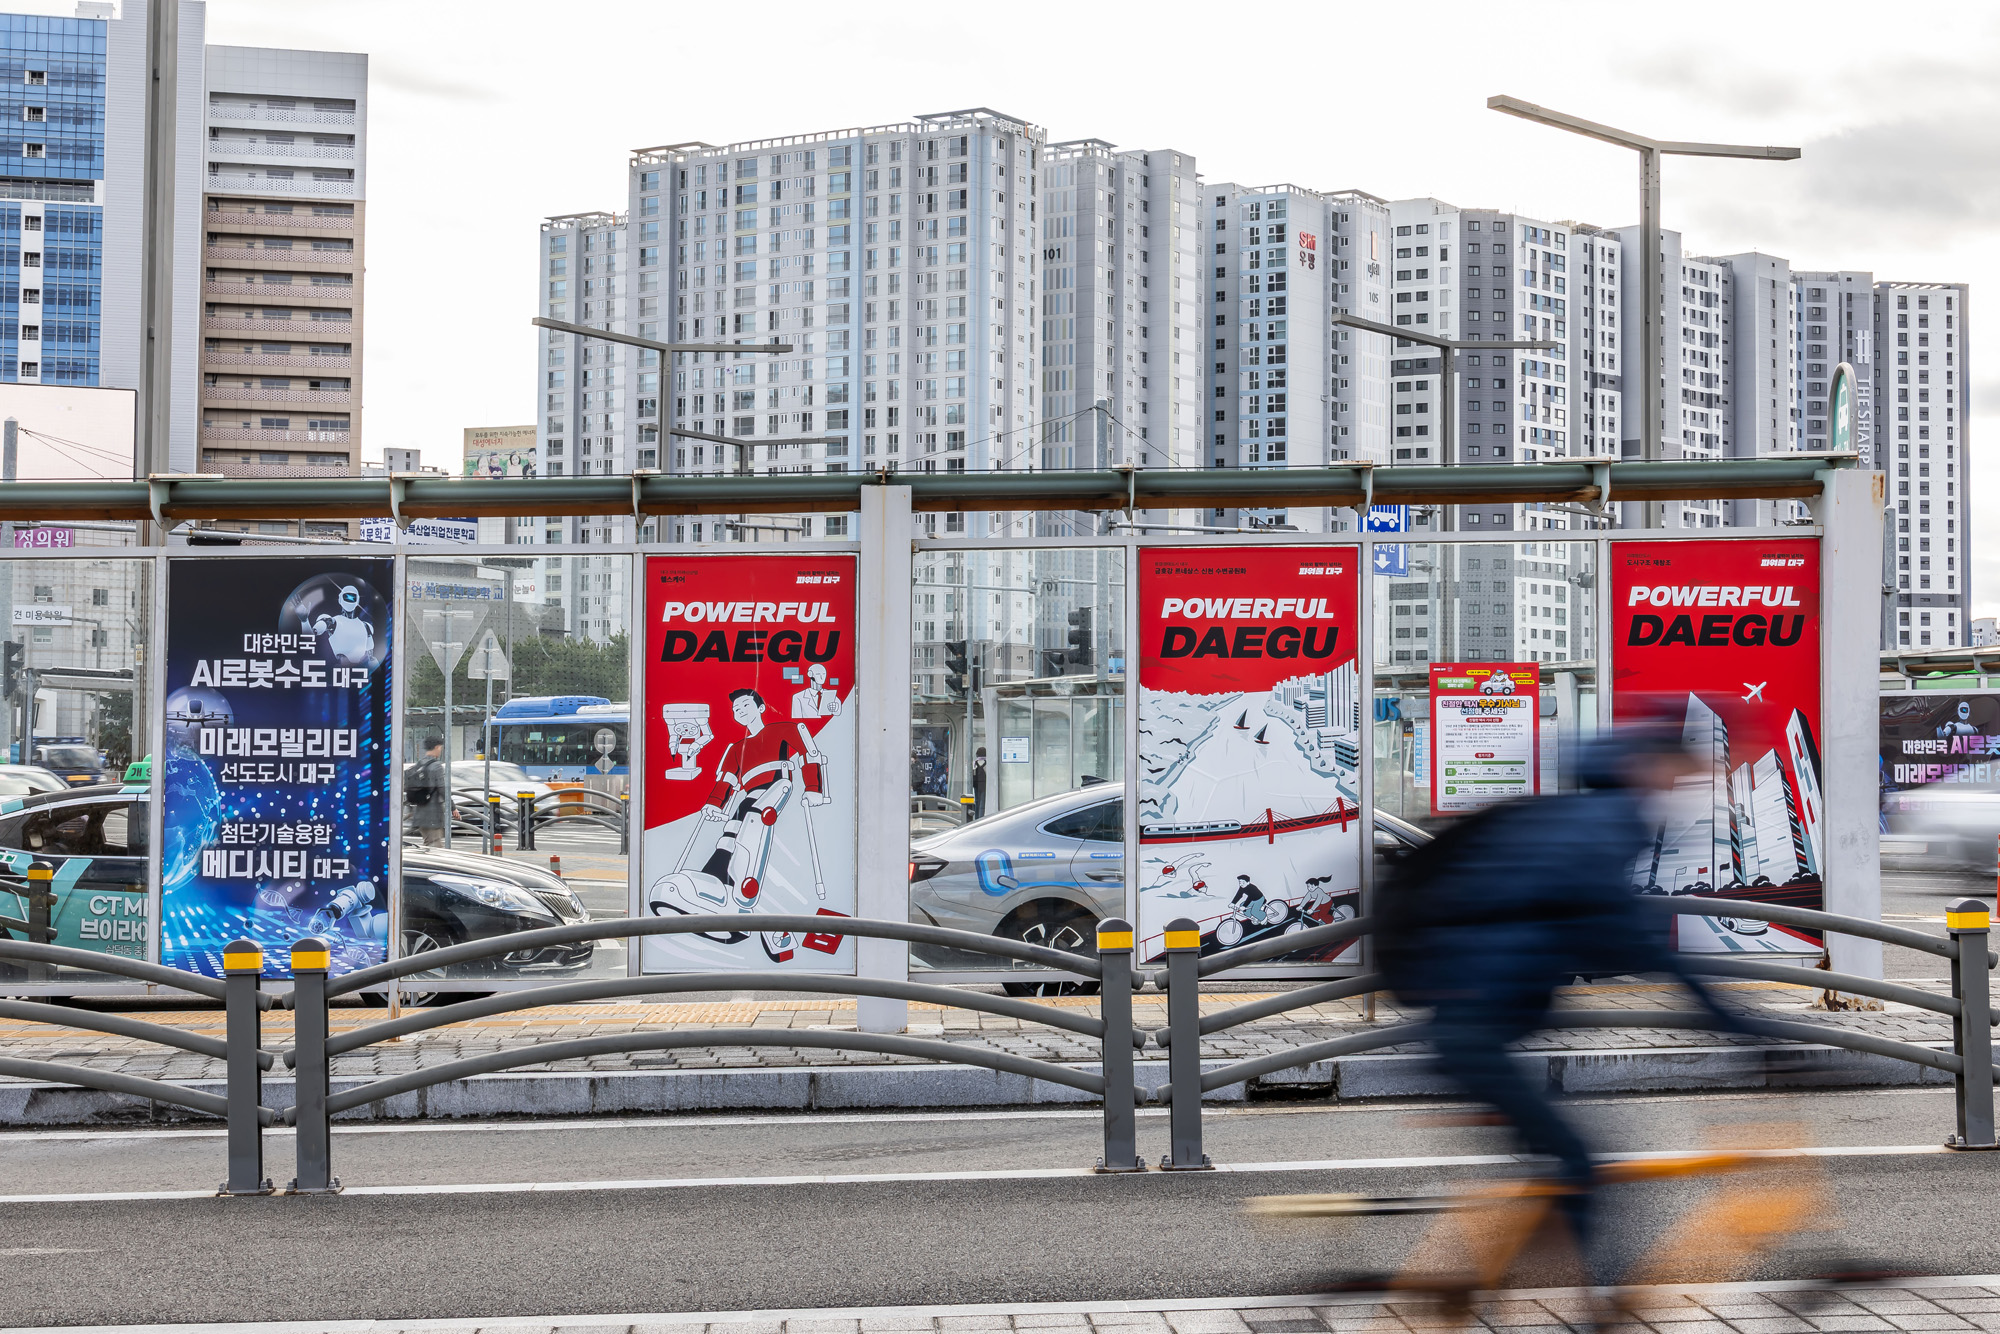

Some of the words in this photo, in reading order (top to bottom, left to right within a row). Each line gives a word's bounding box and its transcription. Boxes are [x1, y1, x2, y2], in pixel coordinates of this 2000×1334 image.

[1299, 231, 1316, 251] SM
[1043, 248, 1061, 260] 101
[1299, 251, 1315, 270] 우방
[1369, 292, 1379, 303] 105
[472, 438, 503, 448] 대성에너지
[14, 529, 70, 548] 성의원
[1155, 567, 1173, 575] 금호강
[1175, 567, 1200, 575] 르네상스
[1325, 567, 1343, 575] 대구
[1787, 559, 1805, 567] 대구
[823, 576, 840, 584] 대구
[407, 585, 503, 600] 업직업전문학교
[1628, 586, 1800, 607] POWERFUL
[662, 601, 836, 623] POWERFUL
[1161, 598, 1334, 619] POWERFUL
[1627, 614, 1805, 647] DAEGU
[244, 633, 316, 654] 대한민국
[661, 630, 841, 663] DAEGU
[1160, 626, 1339, 659] DAEGU
[190, 659, 327, 689] AI로봇수도
[332, 667, 369, 689] 대구
[1374, 698, 1401, 722] US
[200, 728, 357, 758] 미래모빌리티
[1902, 740, 1947, 754] 대한민국
[220, 763, 293, 783] 선도도시
[300, 763, 336, 784] 대구
[1894, 764, 1991, 783] 미래모빌리티
[221, 823, 333, 845] 첨단기술융합
[202, 849, 307, 879] 메디시티
[313, 858, 350, 879] 대구
[105, 945, 132, 955] 삼덕동
